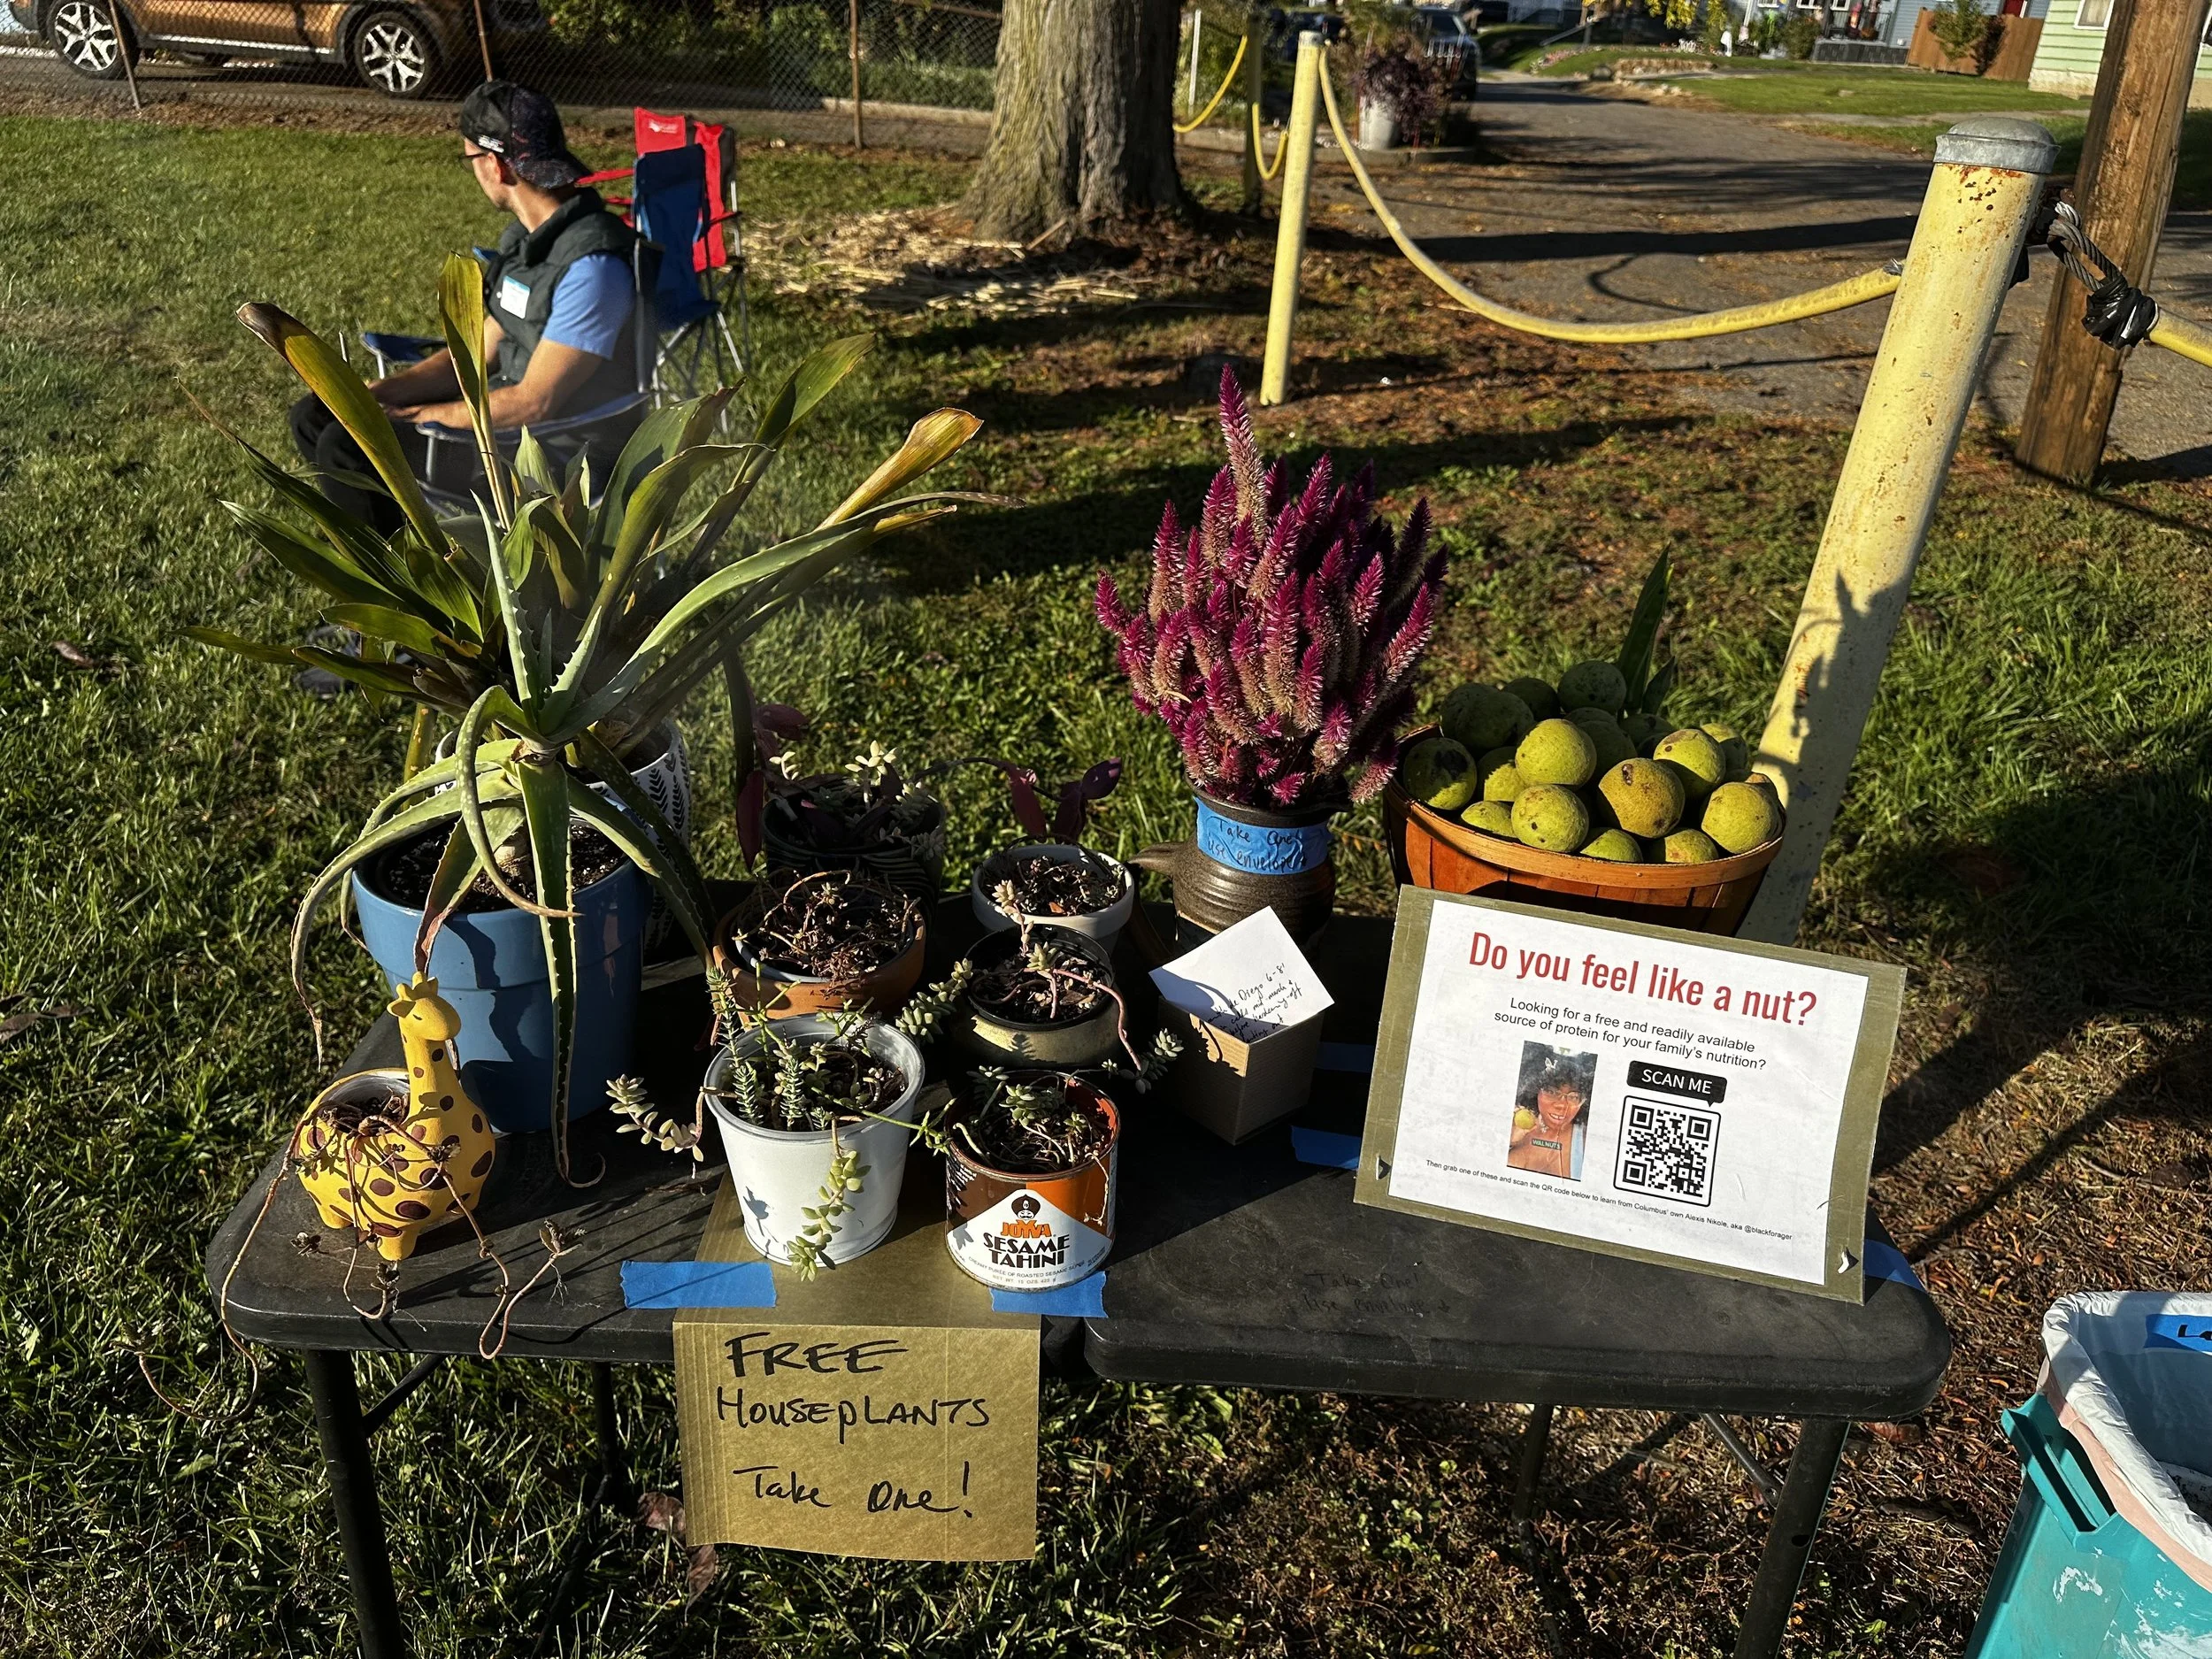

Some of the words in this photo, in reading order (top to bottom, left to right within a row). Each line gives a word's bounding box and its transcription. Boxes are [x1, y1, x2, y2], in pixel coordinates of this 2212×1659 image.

[1210, 816, 1251, 843] Take
[1469, 932, 1508, 970] Do
[1517, 949, 1571, 982] you
[1582, 954, 1640, 994] feel
[1647, 964, 1704, 1006] like
[1713, 986, 1732, 1011] a
[1741, 990, 1817, 1026] nut?
[1494, 1012, 1536, 1027] source
[1540, 1020, 1553, 1030] of
[1555, 1023, 1599, 1040] protein
[1602, 1031, 1620, 1043] for
[1623, 1036, 1652, 1049] your
[1655, 1040, 1702, 1059] family's
[1706, 1051, 1766, 1070] nutrition?
[1510, 997, 1559, 1018] Looking
[1563, 1007, 1580, 1020] for
[1583, 1013, 1591, 1022] a
[1595, 1013, 1619, 1027] free
[1624, 1021, 1647, 1033] and
[1651, 1025, 1694, 1043] readily
[1697, 1033, 1755, 1052] available
[1641, 1069, 1685, 1089] SCAN
[1688, 1077, 1713, 1094] ME
[1532, 1140, 1561, 1149] WALNUTS
[1480, 1171, 1498, 1180] these
[1571, 1190, 1591, 1200] below
[1600, 1195, 1617, 1205] learn
[1617, 1200, 1632, 1209] from
[1633, 1202, 1670, 1215] Columbus'
[1685, 1213, 1705, 1223] Alexis
[1706, 1217, 1729, 1228] Nikole,
[1744, 1225, 1793, 1240] @blackforager
[983, 1233, 1071, 1254] SESAME
[1000, 1219, 1053, 1239] JOYVA
[988, 1248, 1065, 1269] TAHINI
[724, 1331, 909, 1378] FREE
[733, 1465, 832, 1508] Take
[867, 1461, 973, 1518] One!
